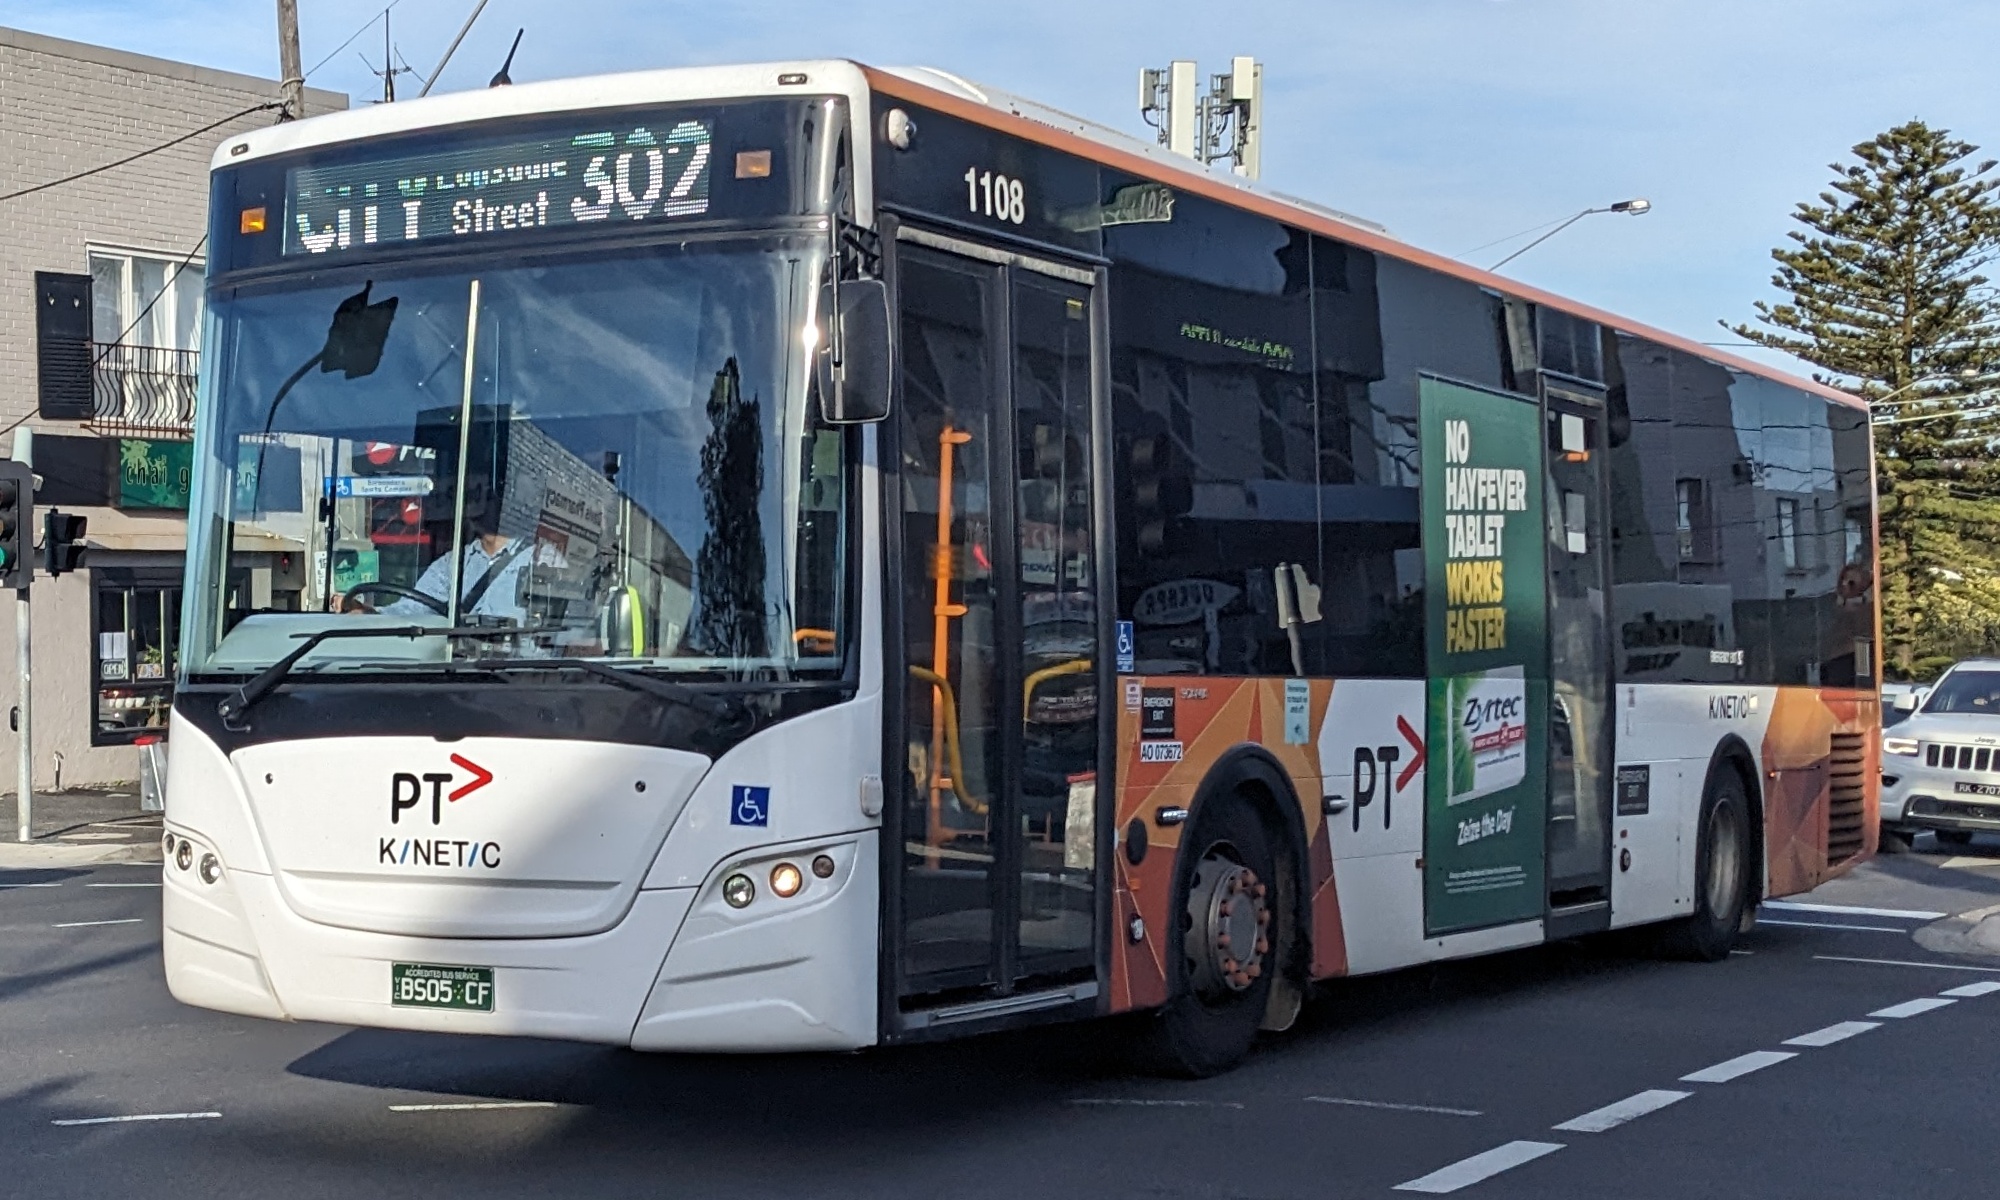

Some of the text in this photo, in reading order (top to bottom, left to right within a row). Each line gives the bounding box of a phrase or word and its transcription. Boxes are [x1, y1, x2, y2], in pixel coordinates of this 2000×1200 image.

[571, 121, 711, 221] 302
[452, 191, 549, 235] Street
[964, 166, 1025, 225] 1108
[1445, 419, 1469, 464] NO
[125, 456, 168, 486] chai
[1445, 467, 1527, 511] HAYFEVER
[1445, 514, 1505, 558] TABLET
[1445, 561, 1503, 607] WORKS
[1446, 607, 1507, 654] FASTER
[103, 663, 124, 675] OPEN
[1463, 696, 1522, 733] Zyrtec
[1975, 736, 1997, 746] Jeep
[1496, 808, 1513, 835] Day
[401, 977, 492, 1006] BS05 CF
[404, 968, 480, 981] ACCREDITED BUS SERVICE
